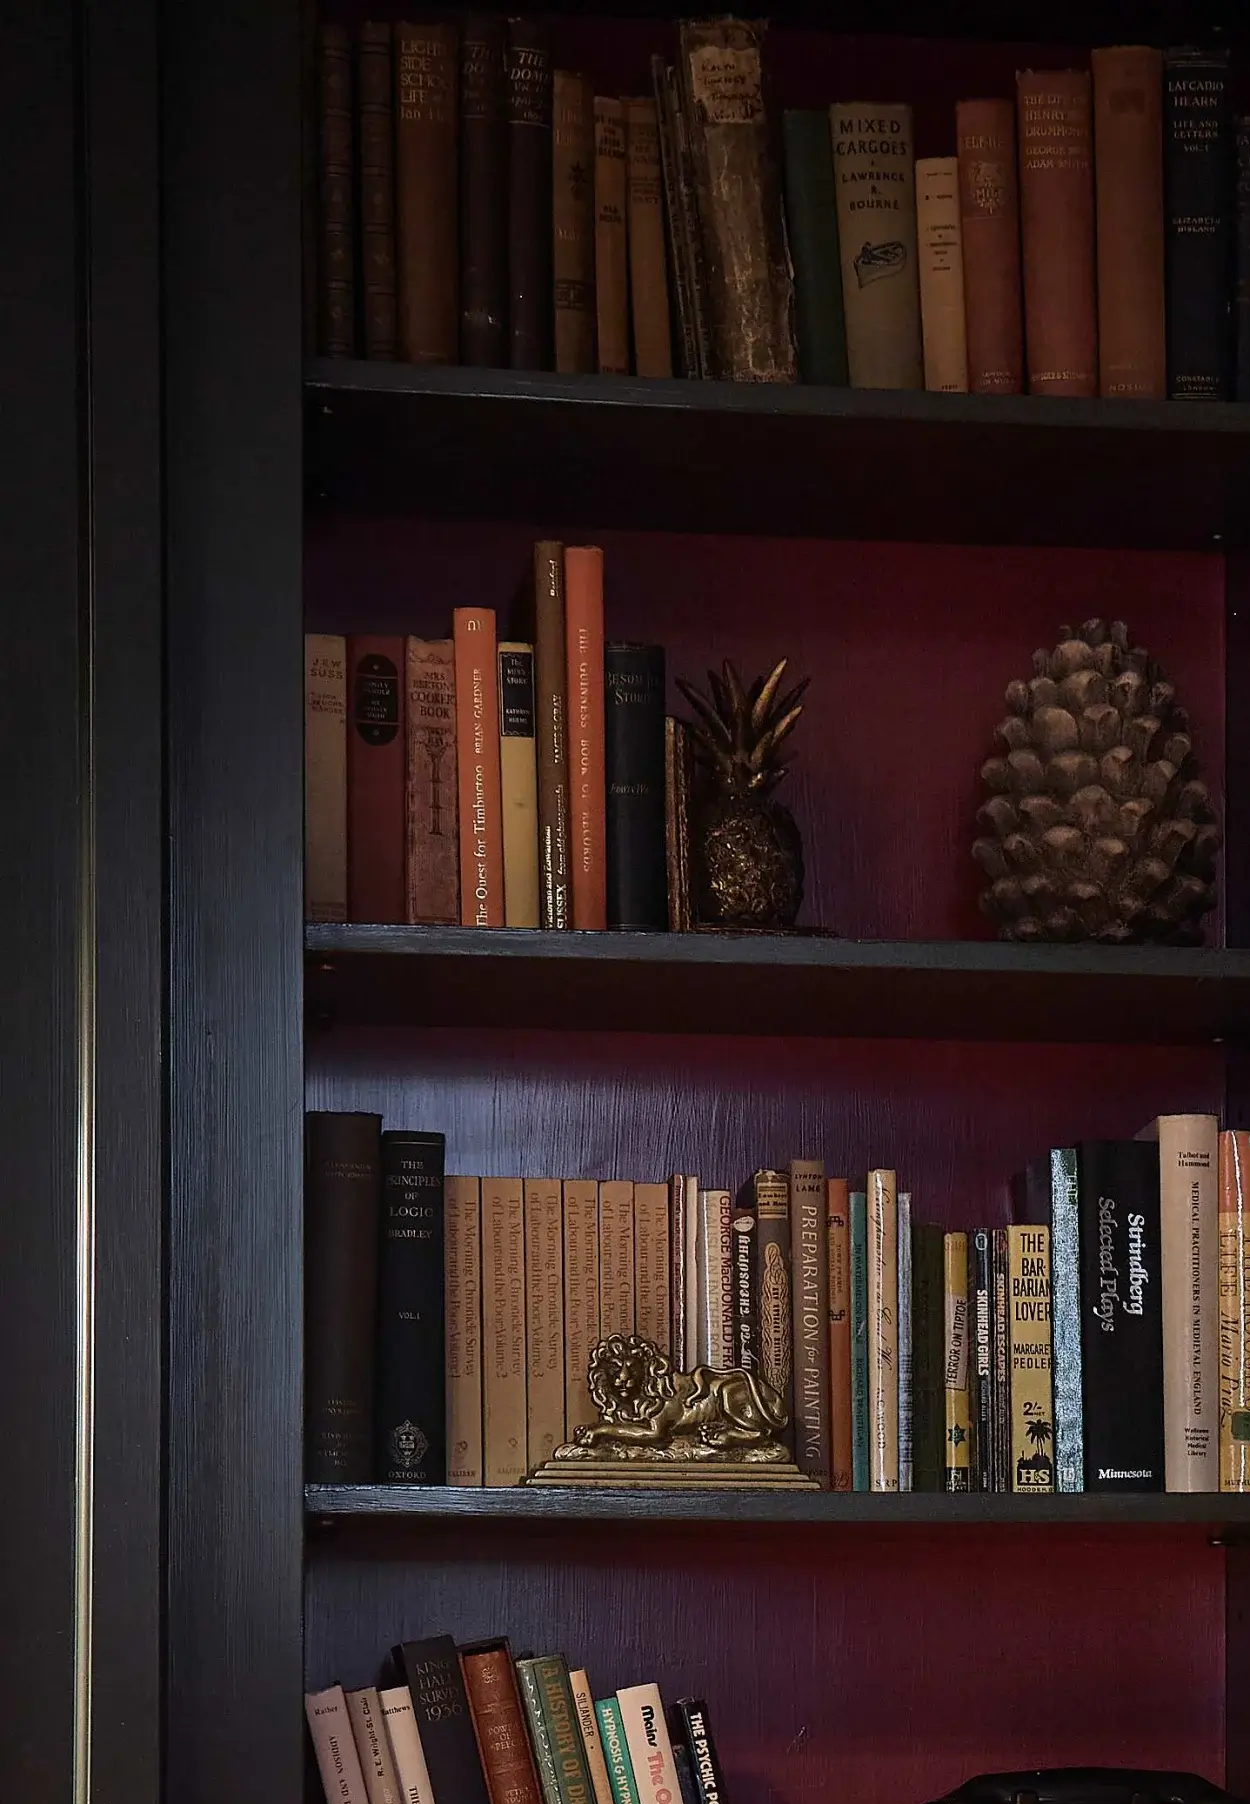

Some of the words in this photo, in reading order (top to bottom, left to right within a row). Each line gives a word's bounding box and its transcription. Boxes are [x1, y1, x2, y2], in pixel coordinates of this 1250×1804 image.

[840, 119, 901, 134] MIXED
[837, 142, 907, 156] CARGOES
[842, 171, 905, 183] LAWRENCE
[849, 200, 900, 212] BOURNE
[578, 627, 589, 654] THE
[420, 705, 450, 720] BOOK
[472, 667, 484, 719] GARDNER
[579, 662, 591, 729] GUINNESS
[474, 722, 485, 755] BRIAN
[472, 764, 485, 835] Timbuctoo
[474, 839, 486, 858] for
[475, 862, 488, 900] Quest
[476, 904, 488, 927] The
[556, 883, 567, 929] SUSSEX
[400, 1160, 425, 1170] THE
[389, 1206, 434, 1217] LOGIC
[464, 1200, 476, 1221] The
[1191, 1181, 1200, 1223] MEDICAL
[388, 1229, 433, 1239] BRADLEY
[567, 1212, 580, 1255] Labour
[719, 1195, 732, 1254] GEORGE
[1020, 1233, 1045, 1252] THE
[1099, 1196, 1119, 1277] Selected
[463, 1224, 477, 1276] Morning
[1123, 1213, 1149, 1316] Strindberg
[1191, 1226, 1200, 1303] PRACTITIONERS
[1219, 1230, 1238, 1297] LIFE
[801, 1205, 820, 1341] PREPARATION
[855, 1256, 866, 1315] WATERMELON
[464, 1279, 477, 1335] Chronicle
[720, 1258, 733, 1333] MacDONALD
[996, 1272, 1006, 1332] SKINHEAD
[1093, 1277, 1120, 1333] Plays
[953, 1299, 967, 1333] TIPTOE
[976, 1289, 989, 1344] SKINHEAD
[466, 1337, 477, 1376] Survey
[804, 1345, 819, 1364] for
[951, 1333, 962, 1347] ON
[996, 1334, 1006, 1383] ESCAPES
[1192, 1320, 1201, 1369] MEDIEVAL
[855, 1358, 865, 1397] RICHARD
[946, 1352, 960, 1384] TERROR
[978, 1345, 990, 1376] GIRLS
[803, 1367, 821, 1459] PAINTING
[1193, 1371, 1201, 1415] ENGLAND
[1098, 1467, 1153, 1481] Minnesota
[542, 1667, 559, 1679] A
[544, 1684, 576, 1754] HISTORY
[576, 1692, 595, 1738] SILJANDER
[640, 1705, 658, 1748] Mains
[690, 1711, 706, 1738] THE
[329, 1735, 344, 1774] ADDISON
[601, 1707, 624, 1767] HYPNOSIS
[562, 1759, 583, 1779] OF
[647, 1751, 664, 1786] The
[695, 1739, 717, 1790] PSYCHIC
